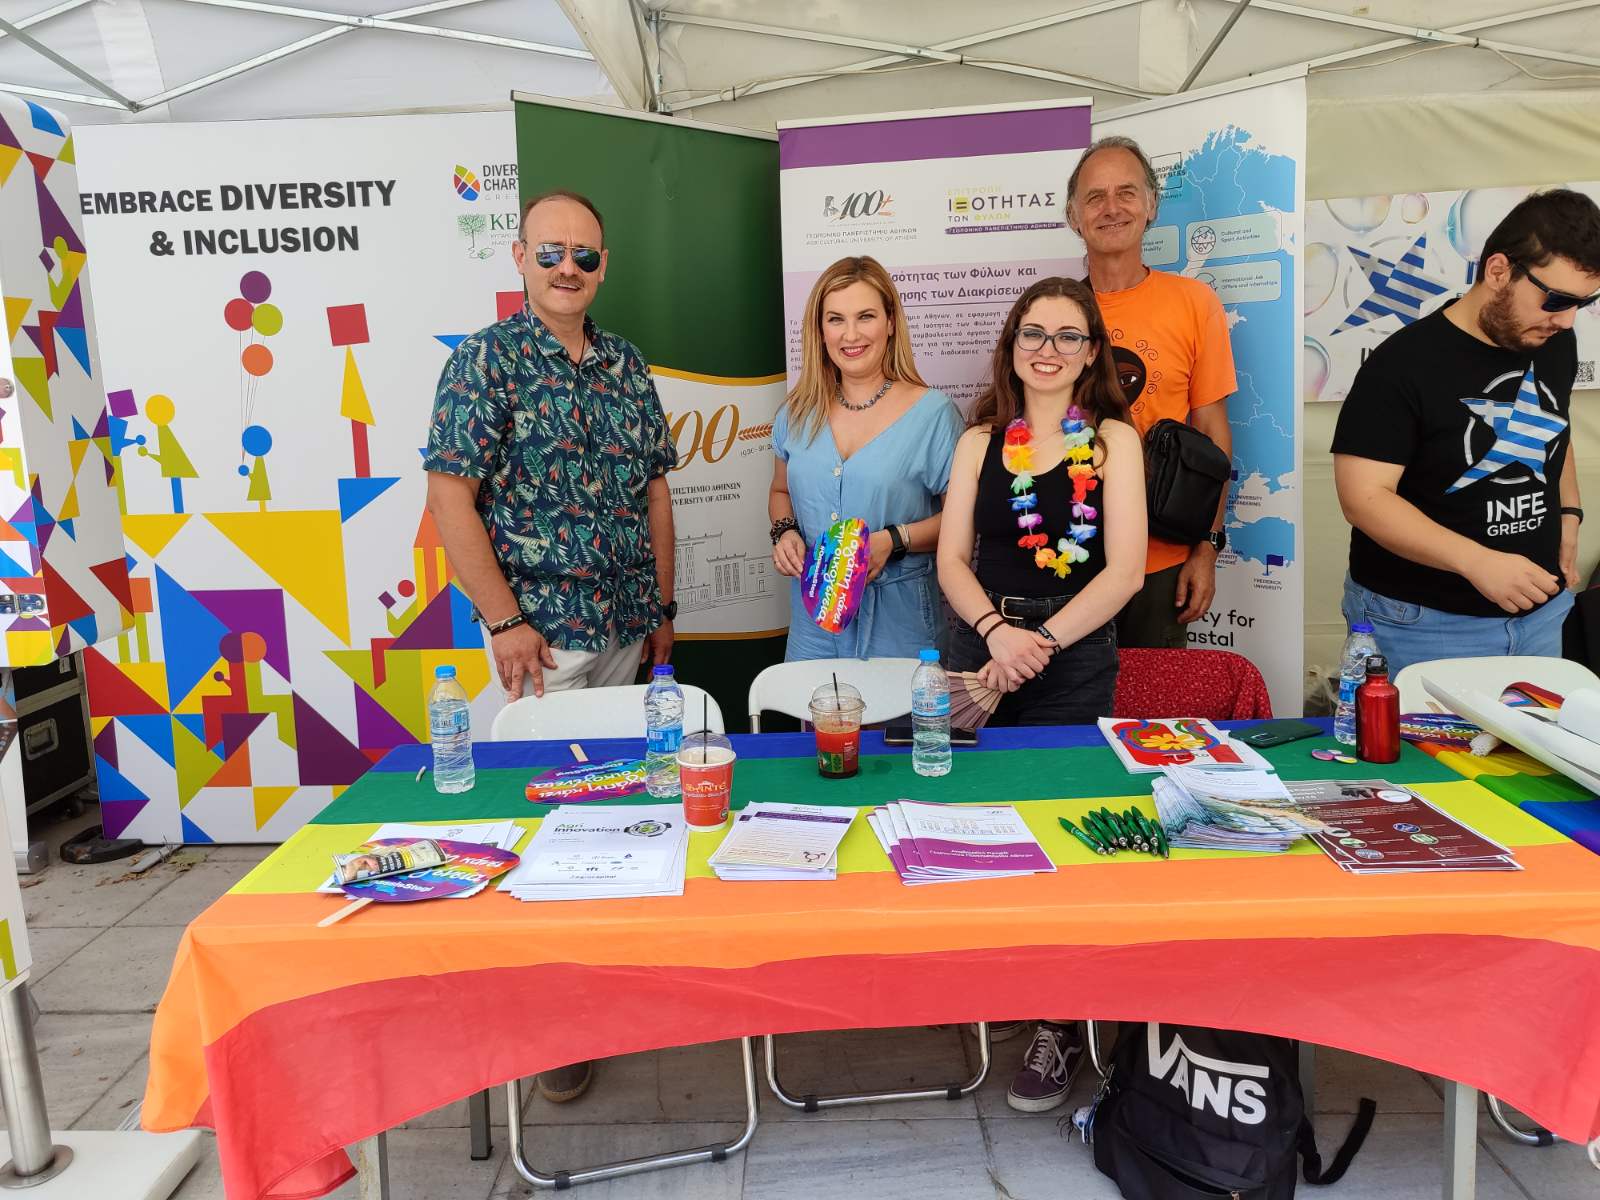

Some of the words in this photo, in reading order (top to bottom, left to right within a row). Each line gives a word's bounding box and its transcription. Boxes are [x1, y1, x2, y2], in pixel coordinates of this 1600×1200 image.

[483, 164, 519, 177] DIVER
[484, 178, 519, 191] CHAR
[79, 190, 213, 215] EMBRACE
[220, 180, 396, 211] DIVERSITY
[489, 213, 519, 230] KE
[149, 230, 175, 256] &
[183, 225, 359, 256] INCLUSION
[889, 272, 940, 283] σότητας
[943, 270, 967, 280] των
[970, 266, 1011, 278] Φύλων
[1017, 266, 1038, 276] και
[900, 291, 927, 302] ησης
[931, 288, 954, 298] των
[665, 404, 740, 471] 00
[670, 484, 711, 495] ΠΙΣΤΗΜΙΟ
[672, 496, 705, 506] IVERSITY
[1487, 491, 1548, 523] INFE
[1227, 609, 1255, 628] for
[1186, 630, 1234, 647] astal
[553, 826, 621, 834] Innovation
[1147, 1022, 1270, 1125] VANS
